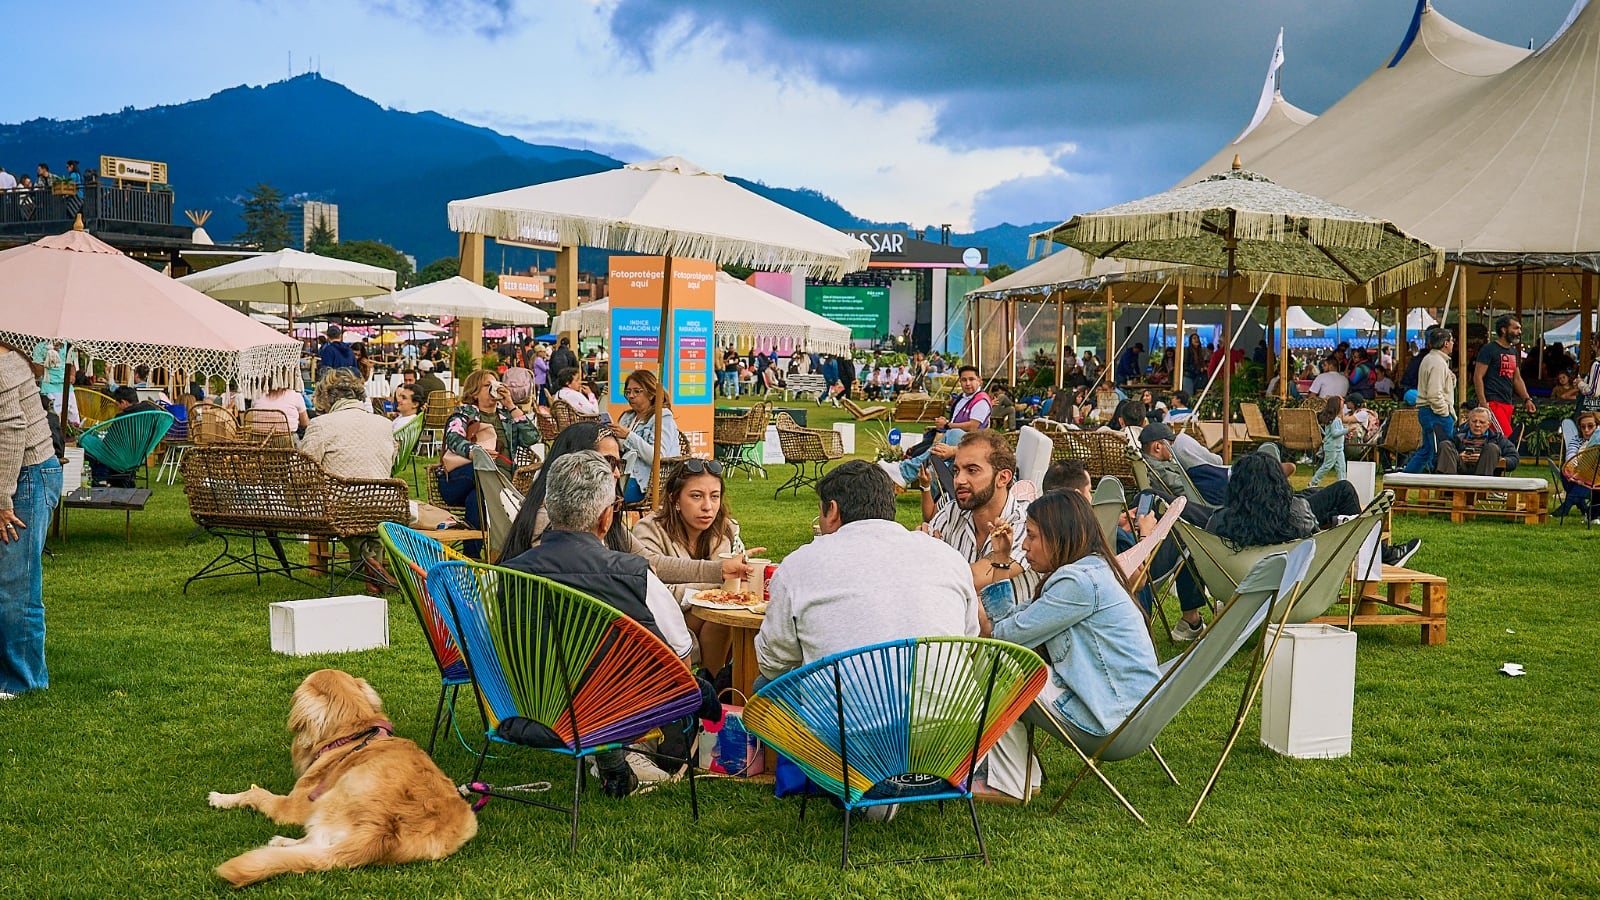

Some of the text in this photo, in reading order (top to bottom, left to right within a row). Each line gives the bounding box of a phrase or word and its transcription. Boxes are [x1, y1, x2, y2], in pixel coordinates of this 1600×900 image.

[611, 270, 664, 280] Fotoprotéget
[503, 281, 540, 292] BEER GARDEN
[630, 279, 649, 289] aquí
